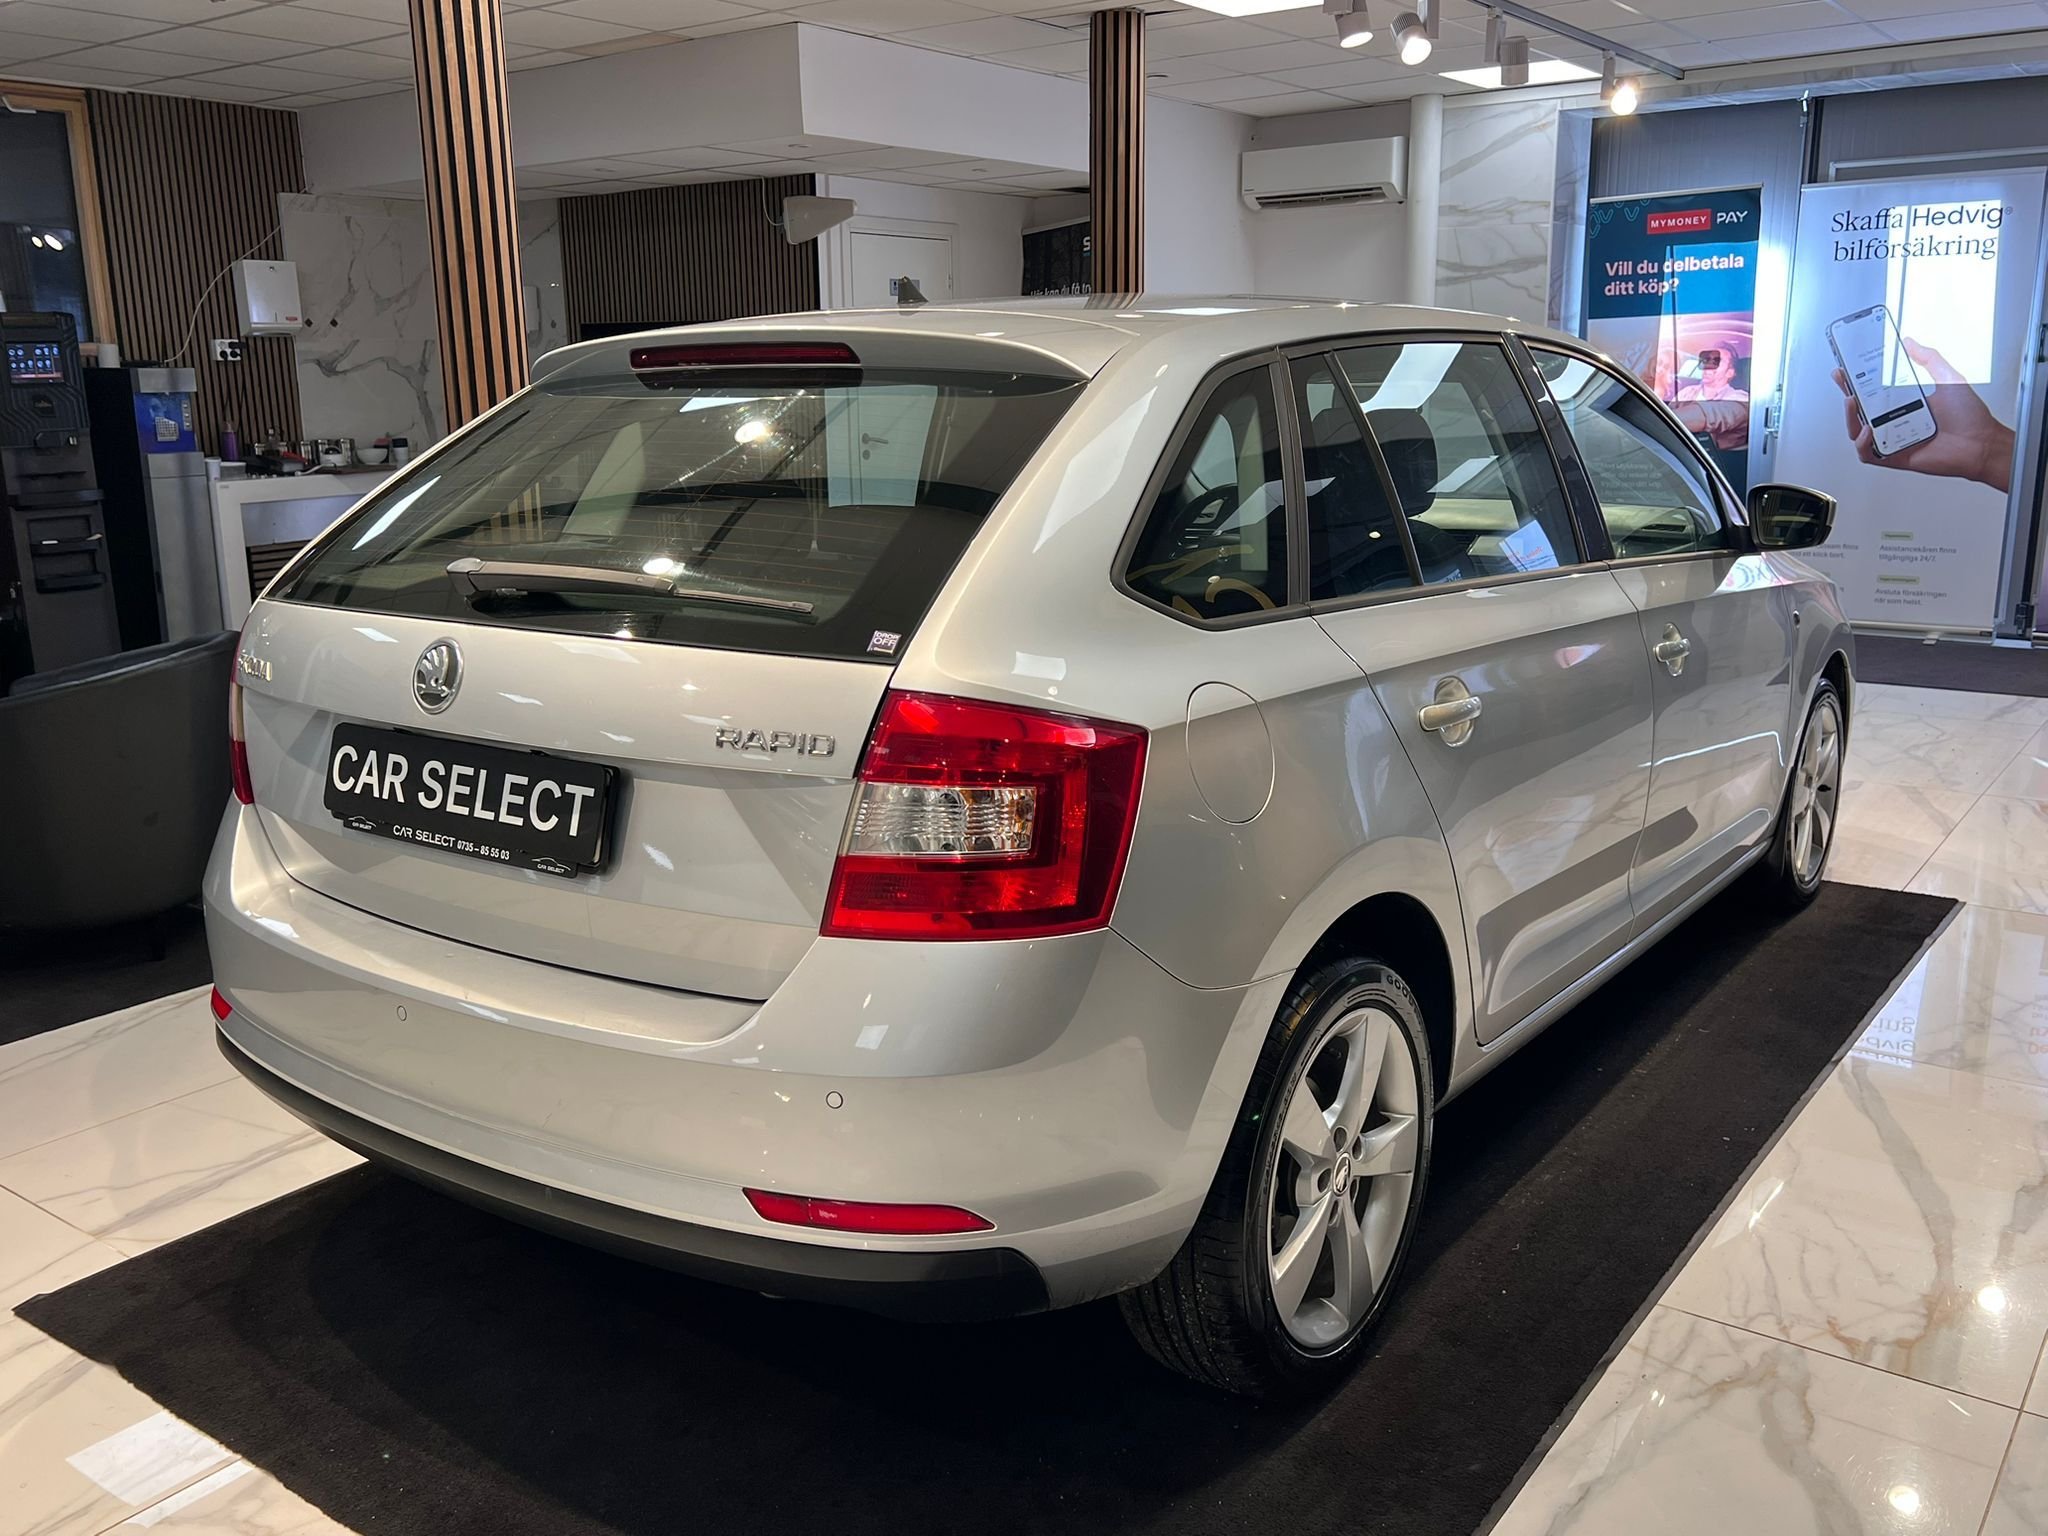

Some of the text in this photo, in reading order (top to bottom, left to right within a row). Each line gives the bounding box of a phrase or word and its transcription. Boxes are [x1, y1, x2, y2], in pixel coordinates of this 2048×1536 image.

[1650, 210, 1748, 229] MYMONEY PAY
[1831, 207, 1903, 233] Skaffa
[1834, 234, 1998, 262] bilförsäkring
[1605, 253, 1744, 276] Vill du delbetala
[1604, 277, 1679, 296] ditt köp?
[715, 726, 836, 757] RAPID
[332, 744, 595, 837] CAR SELECT
[393, 824, 413, 838] CAR
[415, 829, 455, 848] SELECT
[457, 840, 473, 852] 0735
[481, 845, 490, 856] 85
[490, 847, 500, 858] 55
[500, 850, 510, 860] 03
